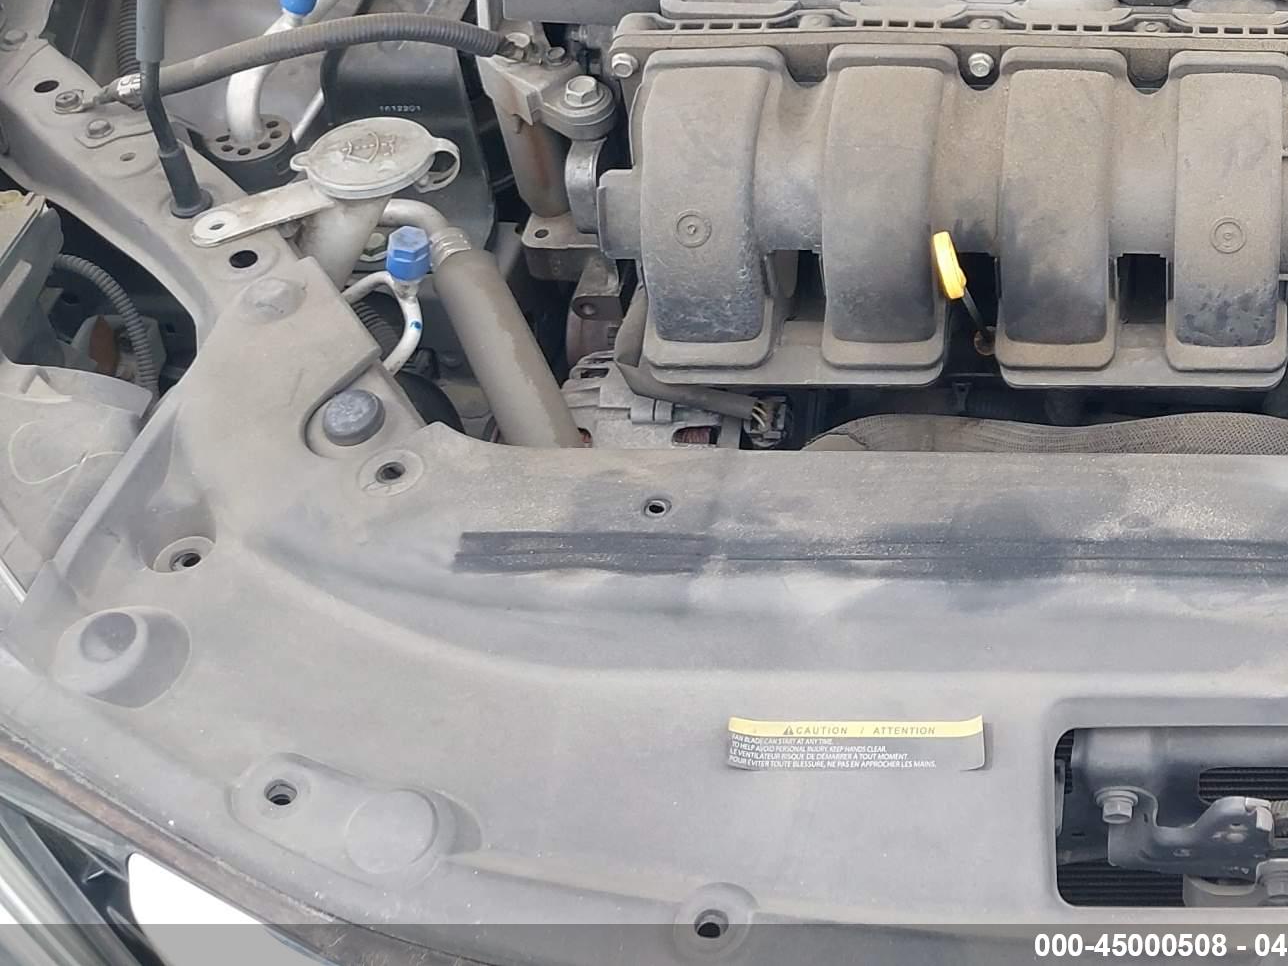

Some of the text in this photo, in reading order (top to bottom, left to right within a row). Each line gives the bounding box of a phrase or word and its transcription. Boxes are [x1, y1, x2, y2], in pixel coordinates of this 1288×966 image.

[796, 726, 848, 735] CAUTION
[873, 726, 936, 735] ATTENTION
[740, 742, 755, 751] HELP
[738, 749, 781, 760] VENTILATEUR
[729, 755, 746, 764] POUR
[770, 760, 791, 768] TOUTE
[827, 760, 836, 768] NE
[837, 760, 850, 768] PAS
[850, 760, 860, 768] EN
[900, 760, 913, 768] LES
